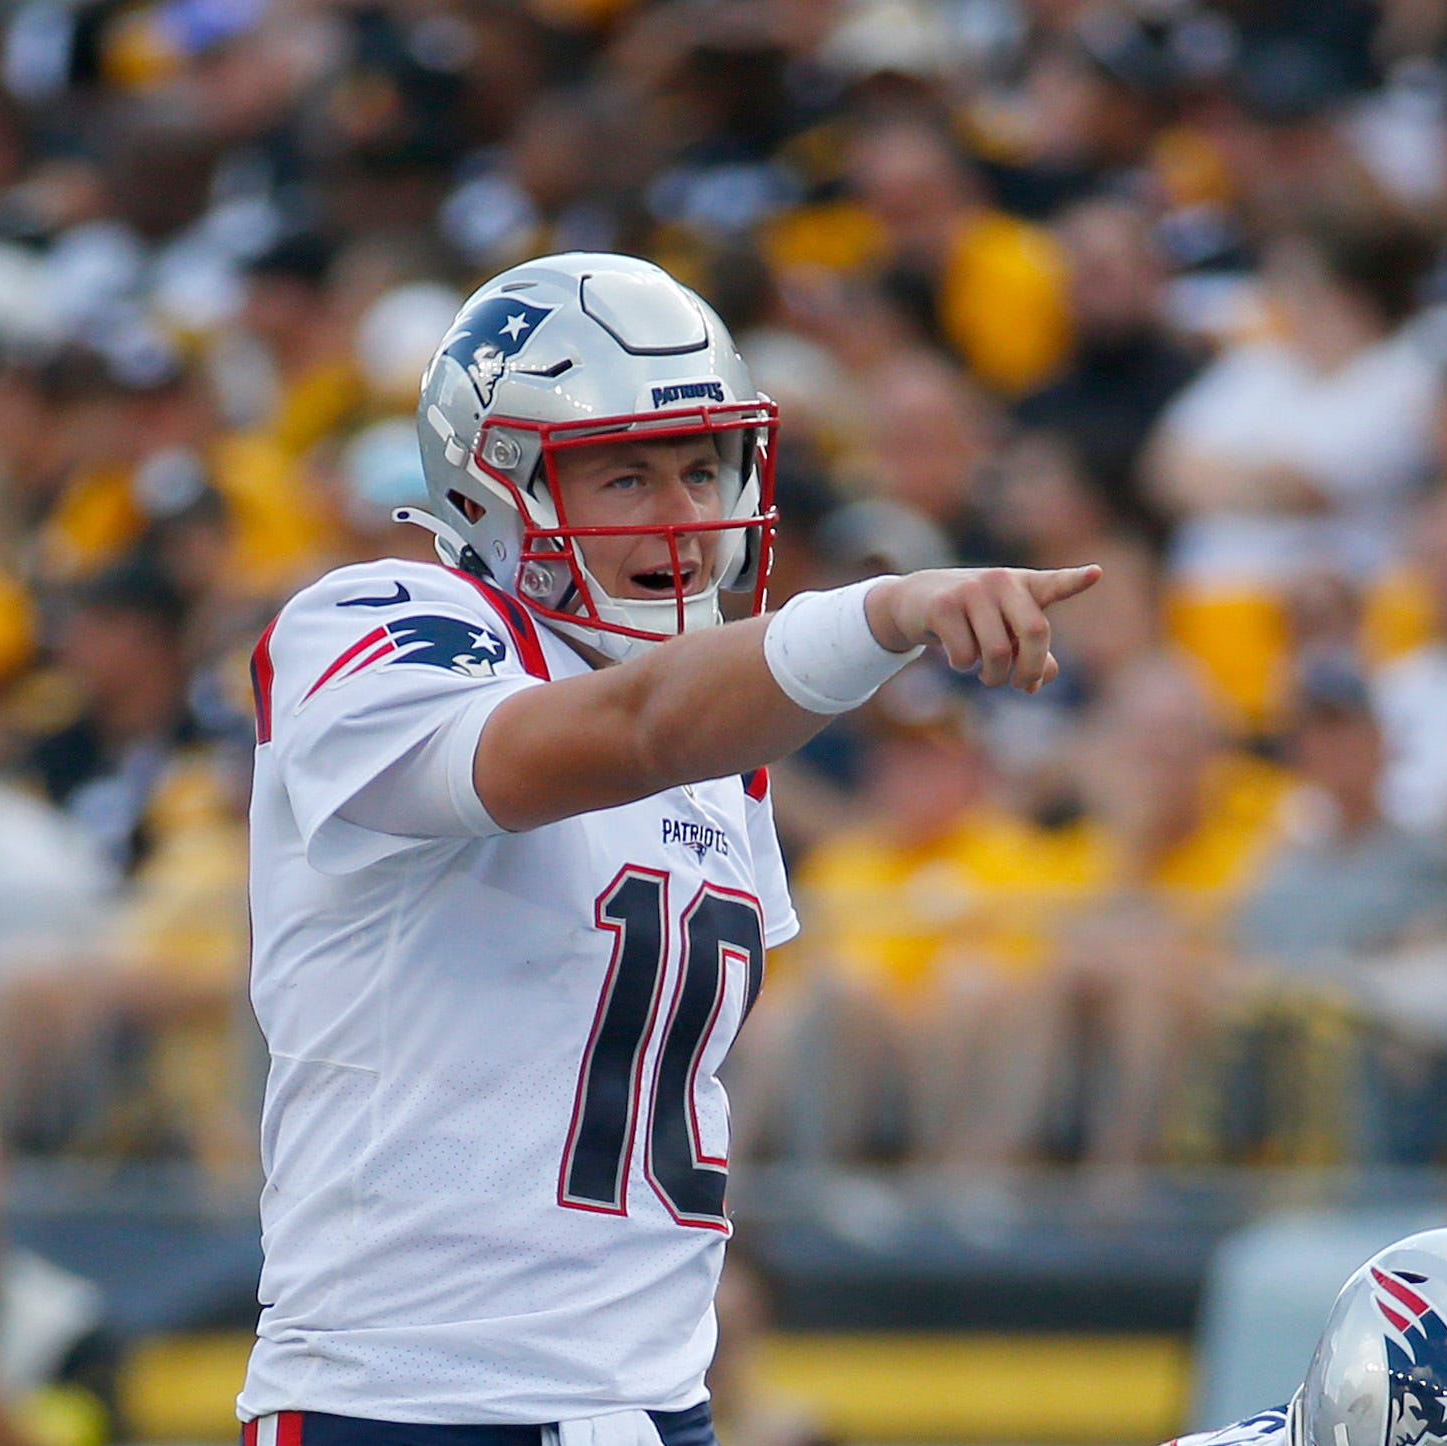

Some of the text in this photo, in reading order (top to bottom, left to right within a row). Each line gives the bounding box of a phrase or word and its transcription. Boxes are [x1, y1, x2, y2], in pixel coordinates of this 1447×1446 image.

[651, 382, 724, 409] PATRIOTS
[662, 818, 728, 856] PATRIOTS
[557, 863, 766, 1236] 10
